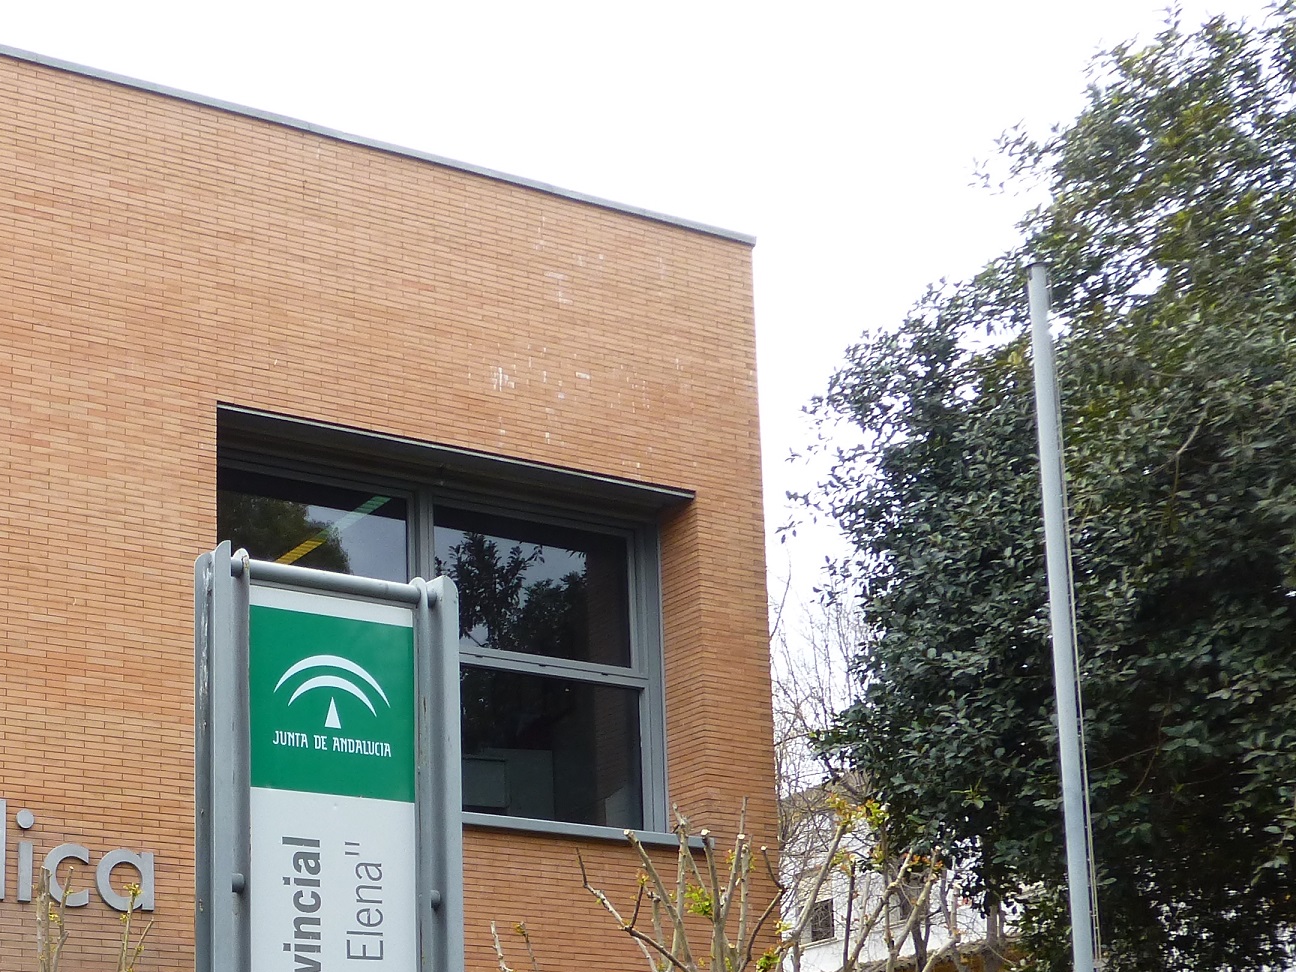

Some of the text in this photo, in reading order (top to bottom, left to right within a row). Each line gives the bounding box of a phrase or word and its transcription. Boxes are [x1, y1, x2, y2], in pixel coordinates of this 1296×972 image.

[272, 730, 392, 758] JUNTA DE ANDALUCIA
[344, 841, 385, 961] Elena"
